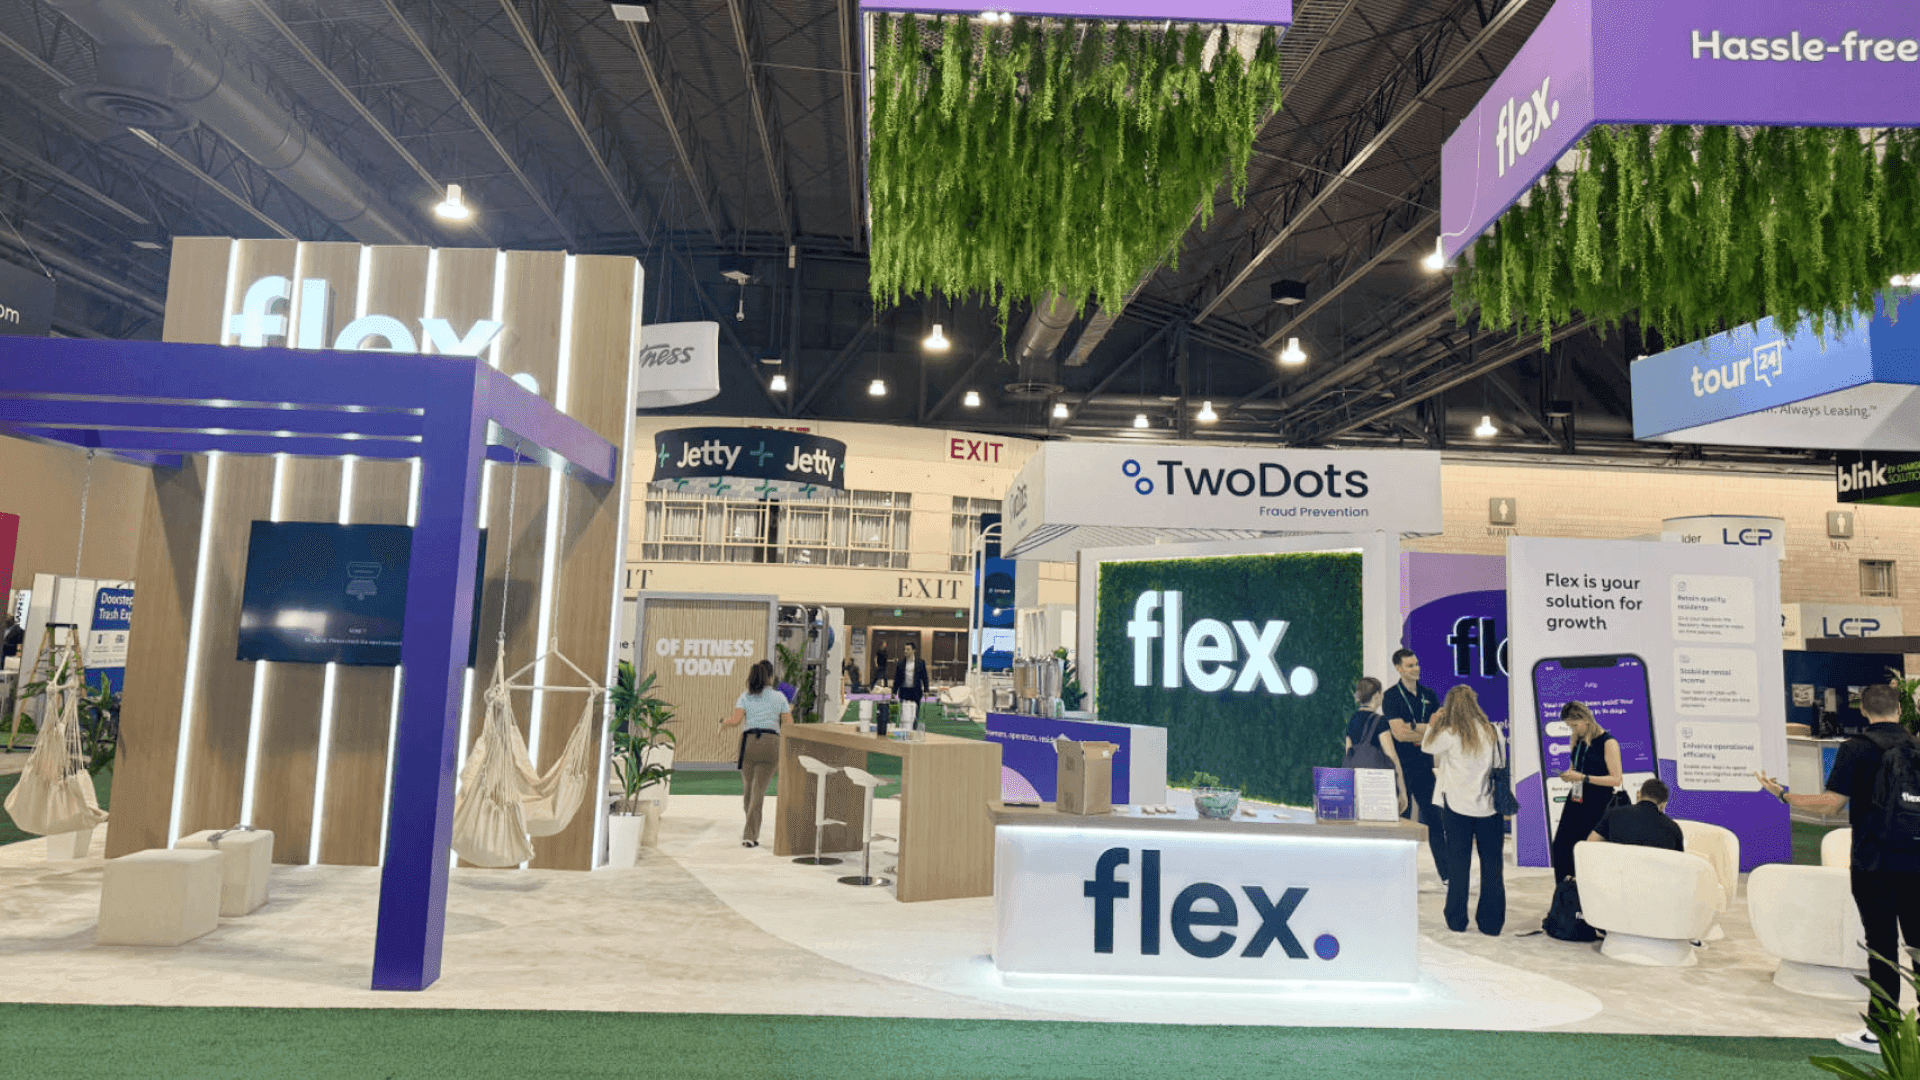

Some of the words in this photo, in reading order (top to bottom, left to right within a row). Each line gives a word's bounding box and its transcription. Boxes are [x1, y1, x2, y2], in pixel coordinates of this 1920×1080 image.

[1691, 30, 1919, 62] Hassle-free
[1496, 77, 1560, 178] flex.
[1691, 356, 1752, 397] tour
[1758, 350, 1778, 371] 24
[1780, 404, 1820, 418] Always
[676, 439, 742, 471] Jetty
[951, 438, 1004, 463] EXIT
[785, 445, 836, 482] Jetty
[1157, 460, 1369, 499] TwoDots
[1837, 459, 1888, 493] blink
[1259, 506, 1297, 518] Fraud
[1300, 506, 1369, 518] Prevention
[1722, 527, 1773, 546] LCP
[626, 569, 653, 589] IT
[898, 577, 963, 600] EXIT
[1546, 573, 1579, 588] Flex
[1584, 573, 1597, 588] is
[1601, 578, 1640, 592] your
[1546, 594, 1615, 609] solution
[1620, 596, 1643, 610] for
[1546, 615, 1607, 632] growth
[655, 638, 681, 656] OF
[684, 639, 755, 656] FITNESS
[1127, 589, 1319, 697] flex.
[674, 658, 736, 676] TODAY
[1083, 846, 1340, 961] flex.
